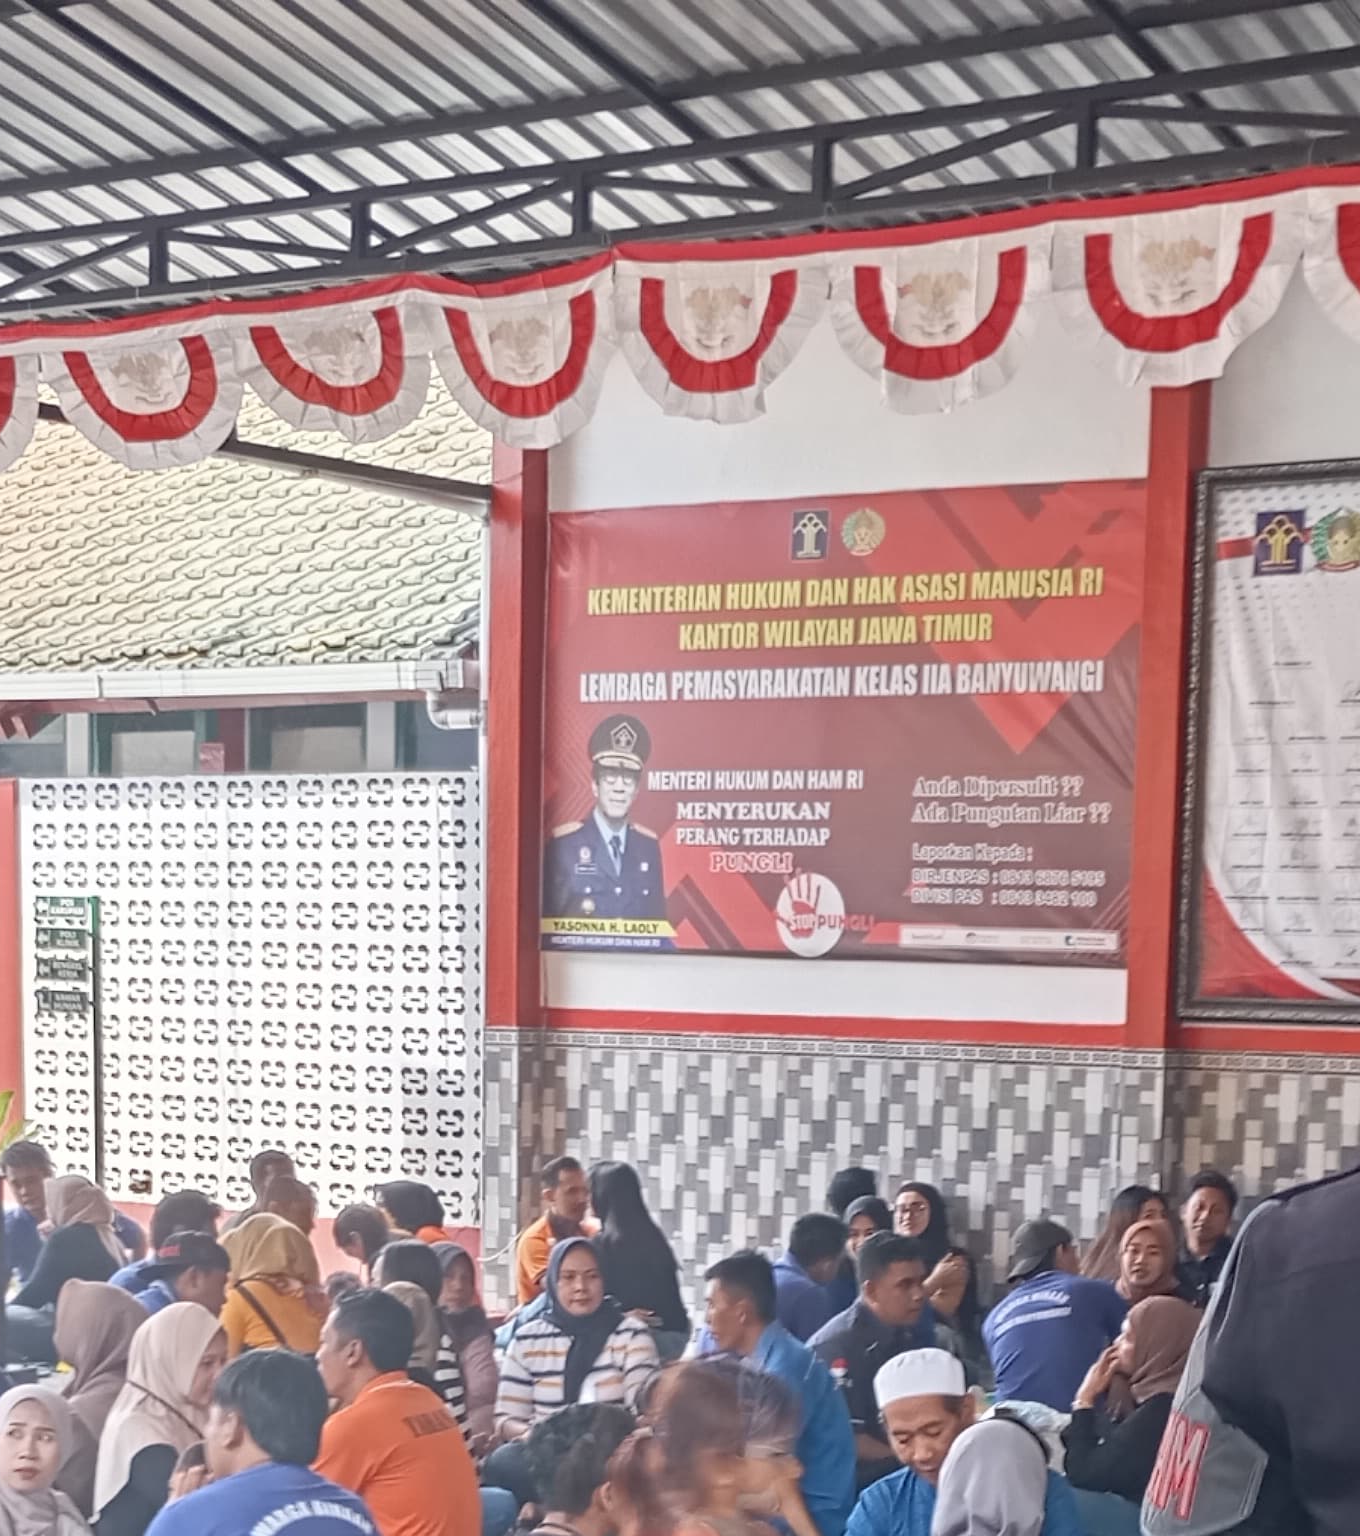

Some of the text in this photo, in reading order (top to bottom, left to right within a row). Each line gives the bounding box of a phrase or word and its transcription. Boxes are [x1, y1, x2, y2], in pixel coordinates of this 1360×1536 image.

[587, 567, 1105, 616] KEMENTERIAN HUKUM DAN HAK ASASI MANUSIA RI
[679, 612, 993, 651] KANTOR WILAYAH JAWA TIMUR
[580, 660, 1105, 703] LEMBAGA PEMASYARAKATAN KELAS IIA BANYUWANGI
[647, 769, 864, 791] MENTERI HUKUM DAN HAM RI
[912, 775, 1084, 801] Anda Dipersulit ??
[676, 801, 832, 821] MENYERUKAN
[911, 802, 1113, 828] Ada Pungutan Liar ??
[676, 826, 831, 847] PERANG TERHADAP
[709, 851, 794, 873] PUNGLI
[553, 921, 607, 932] YASONNA
[623, 923, 660, 934] LAOLY
